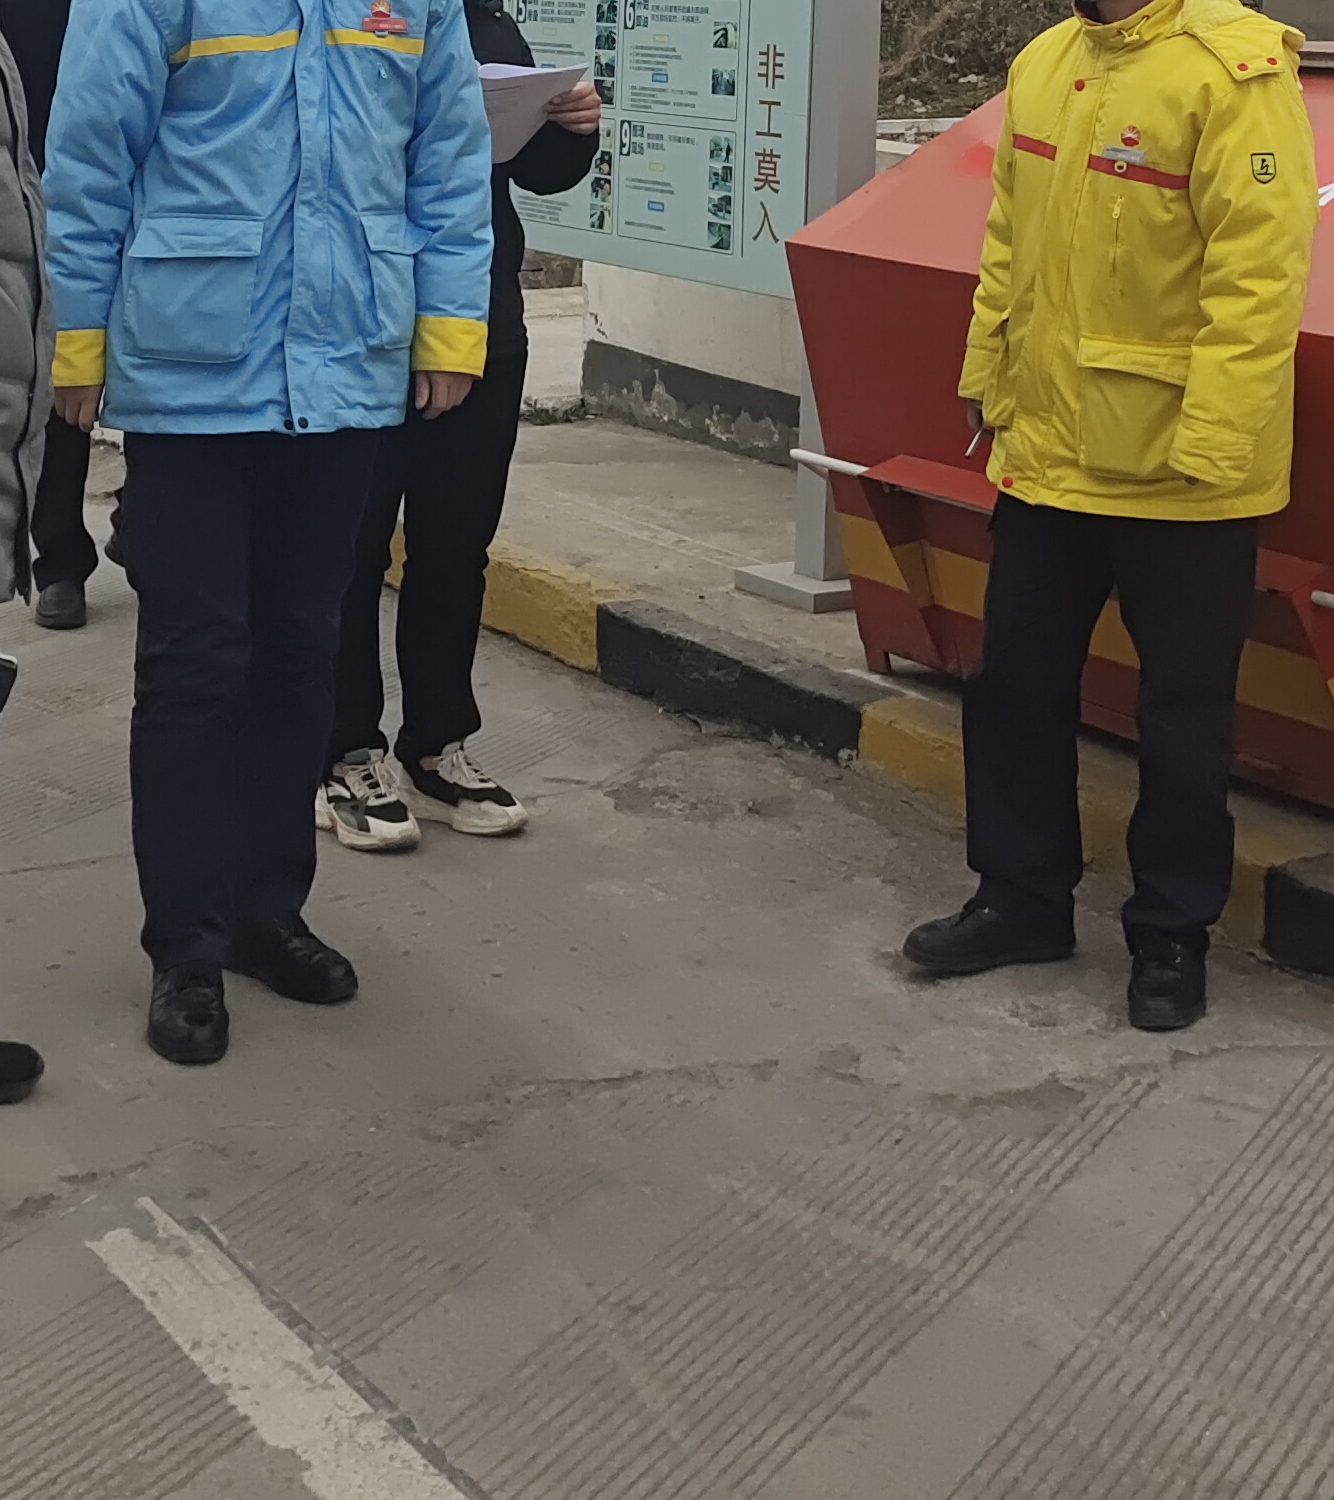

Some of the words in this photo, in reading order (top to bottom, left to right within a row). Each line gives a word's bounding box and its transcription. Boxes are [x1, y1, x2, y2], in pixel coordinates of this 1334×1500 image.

[621, 121, 630, 155] 9
[752, 43, 785, 245] 非工莫入
